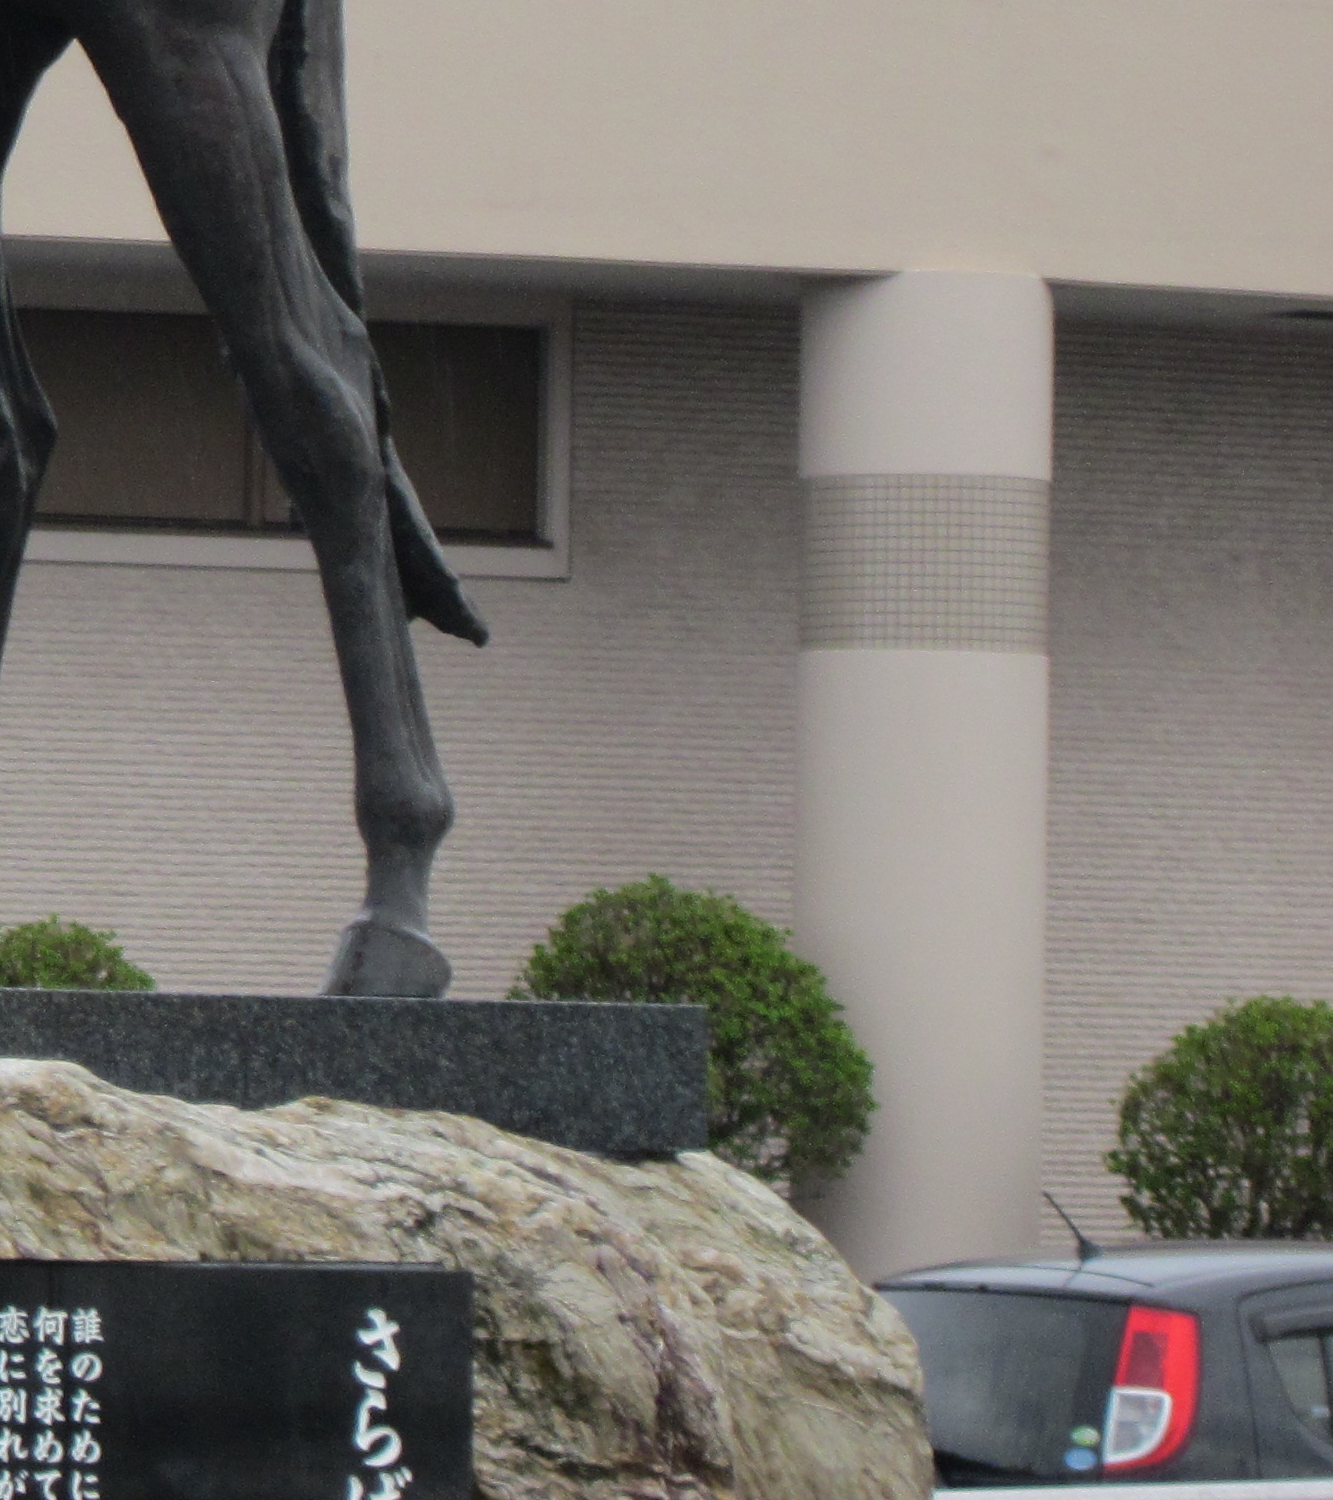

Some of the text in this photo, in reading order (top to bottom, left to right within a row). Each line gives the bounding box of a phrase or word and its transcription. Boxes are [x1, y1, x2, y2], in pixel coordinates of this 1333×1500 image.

[33, 1306, 68, 1500] 何を求めて
[71, 1308, 104, 1500] 誰のために
